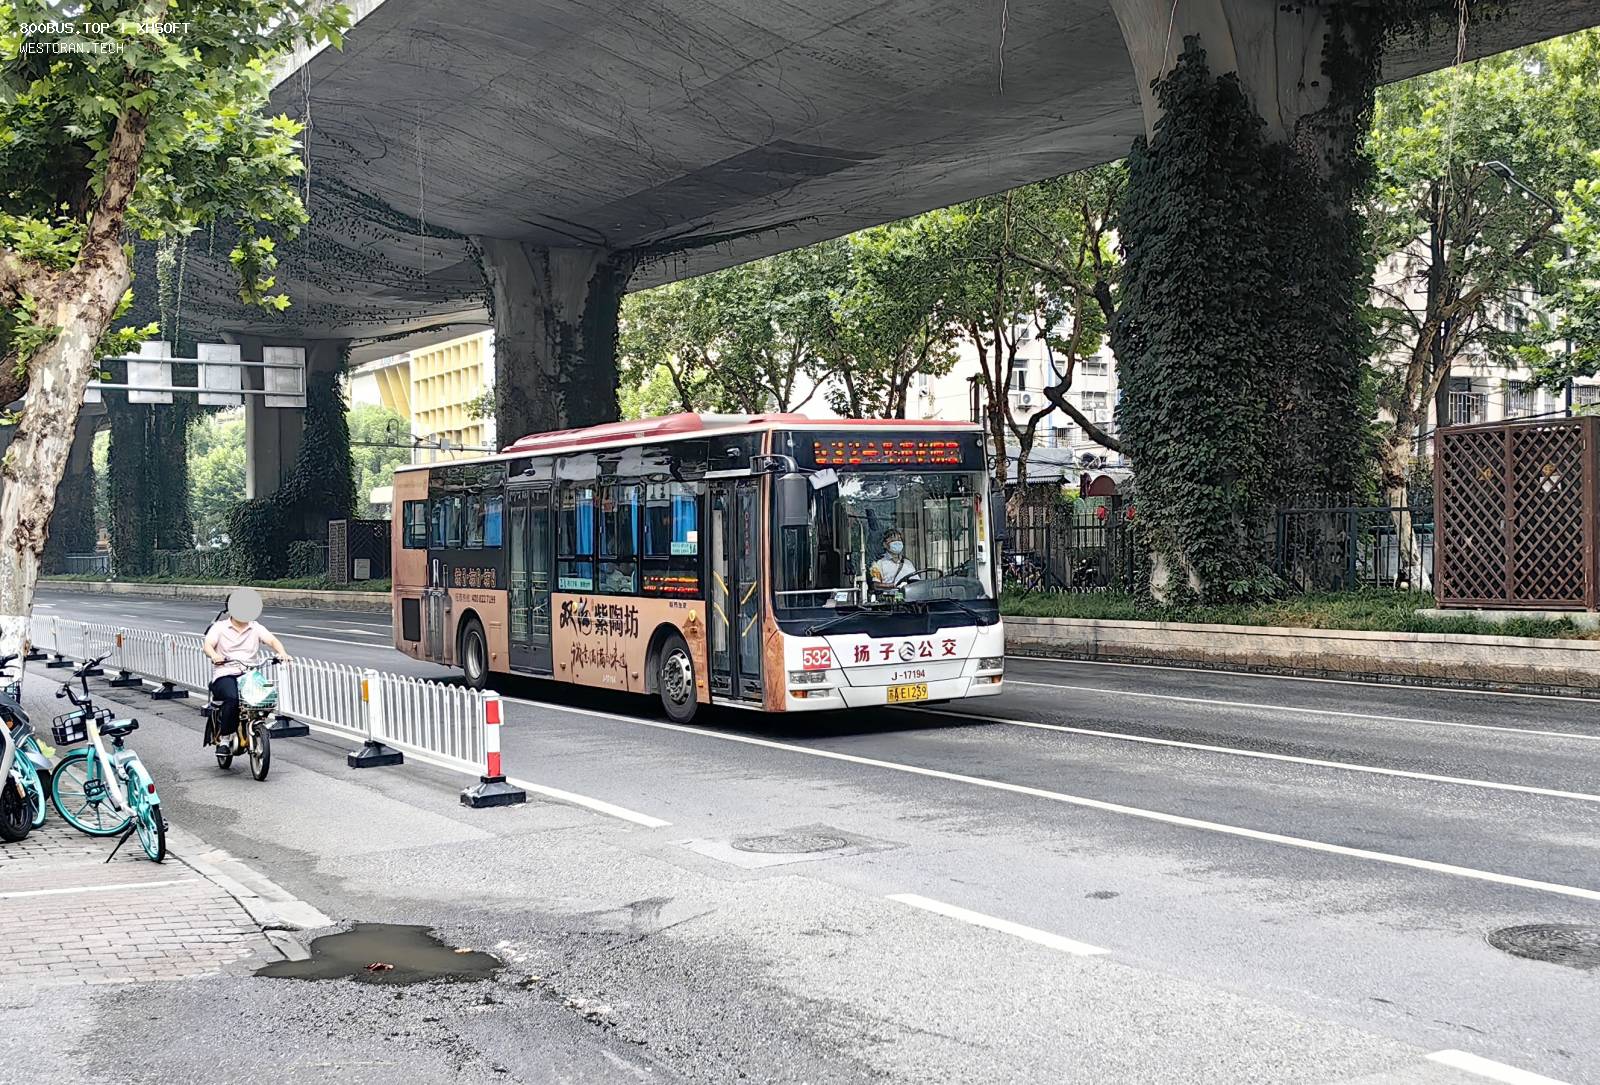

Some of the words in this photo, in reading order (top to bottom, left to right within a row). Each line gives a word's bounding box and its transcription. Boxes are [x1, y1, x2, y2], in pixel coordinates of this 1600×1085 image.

[803, 650, 831, 666] 532
[854, 642, 895, 663] 扬子
[918, 638, 957, 657] 公交
[891, 669, 926, 681] J-17194
